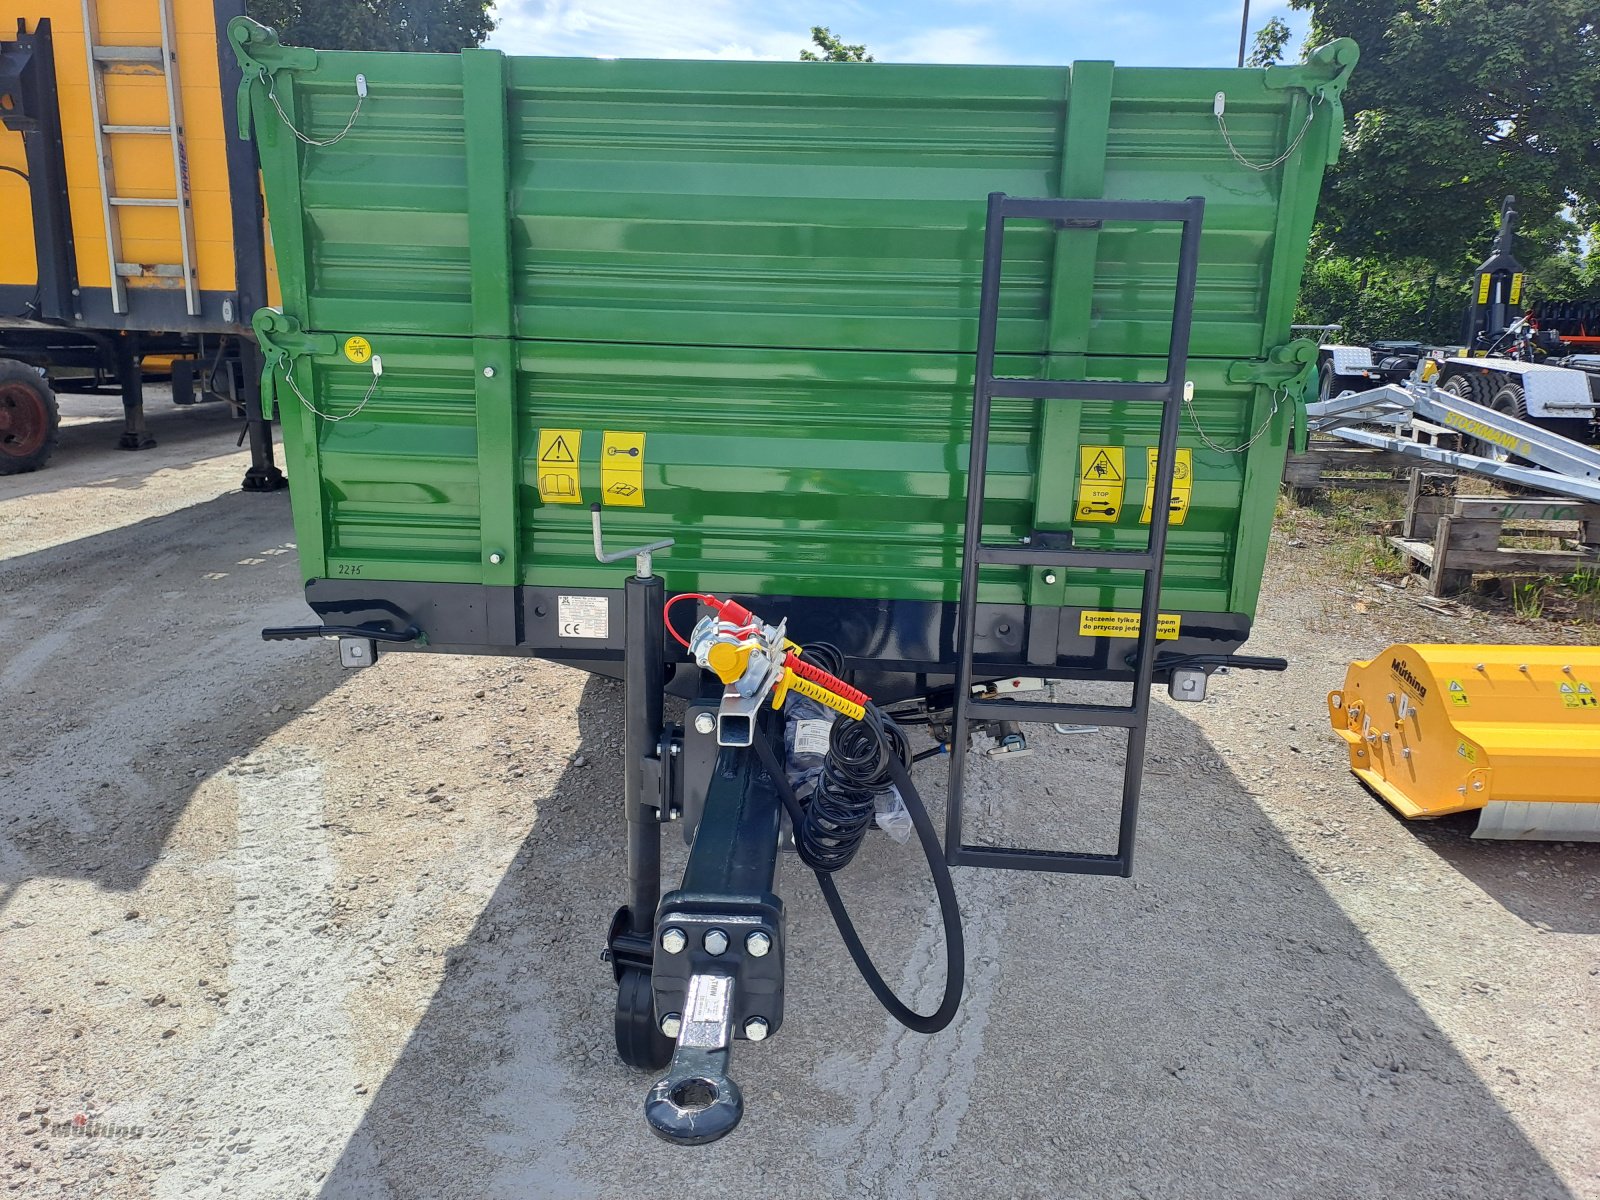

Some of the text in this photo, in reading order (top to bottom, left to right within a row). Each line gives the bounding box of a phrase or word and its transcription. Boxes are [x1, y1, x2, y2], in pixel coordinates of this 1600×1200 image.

[1444, 411, 1519, 450] STOCKMANN
[338, 564, 364, 575] 2275
[1085, 615, 1116, 623] Łączenie
[1391, 658, 1427, 699] Müthing
